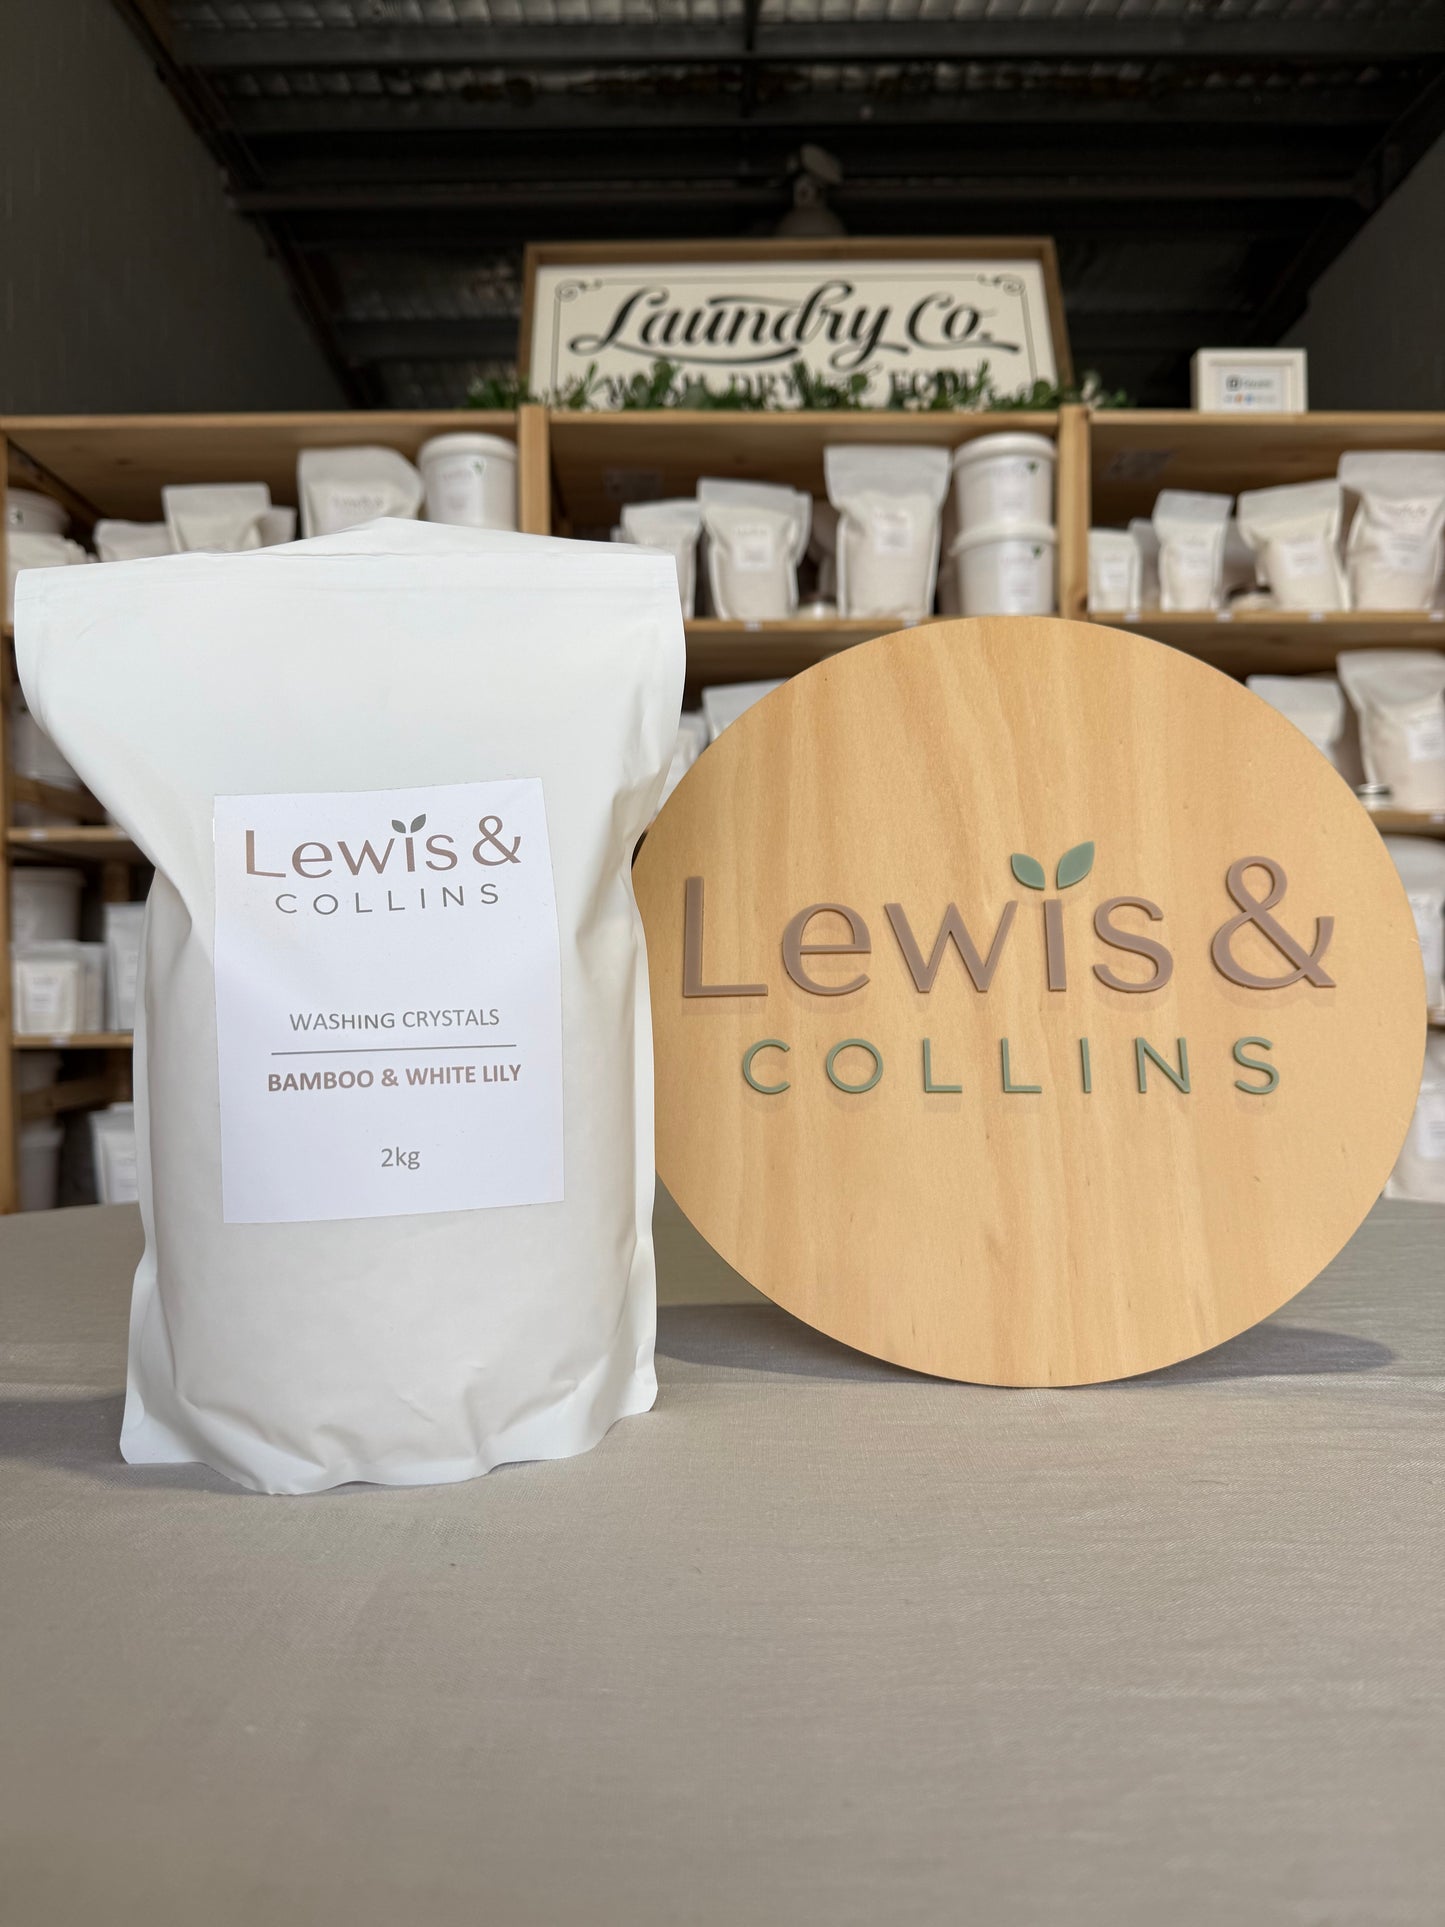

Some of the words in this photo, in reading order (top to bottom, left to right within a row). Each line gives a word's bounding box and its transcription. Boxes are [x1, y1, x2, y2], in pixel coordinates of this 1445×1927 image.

[568, 279, 909, 372] Laundry
[906, 292, 1020, 354] Co.
[245, 813, 459, 878] Lewis
[472, 815, 522, 866] &
[275, 883, 499, 915] COLLINS
[682, 841, 1174, 998] Lewis
[1211, 855, 1337, 990] &
[289, 1012, 396, 1031] WASHING
[402, 1008, 500, 1028] CRYSTALS
[267, 1069, 375, 1092] BAMBOO
[381, 1068, 399, 1087] &
[405, 1065, 477, 1086] WHITE
[482, 1064, 522, 1083] LILY
[742, 1036, 1281, 1095] COLLINS
[380, 1146, 421, 1170] 2kg
